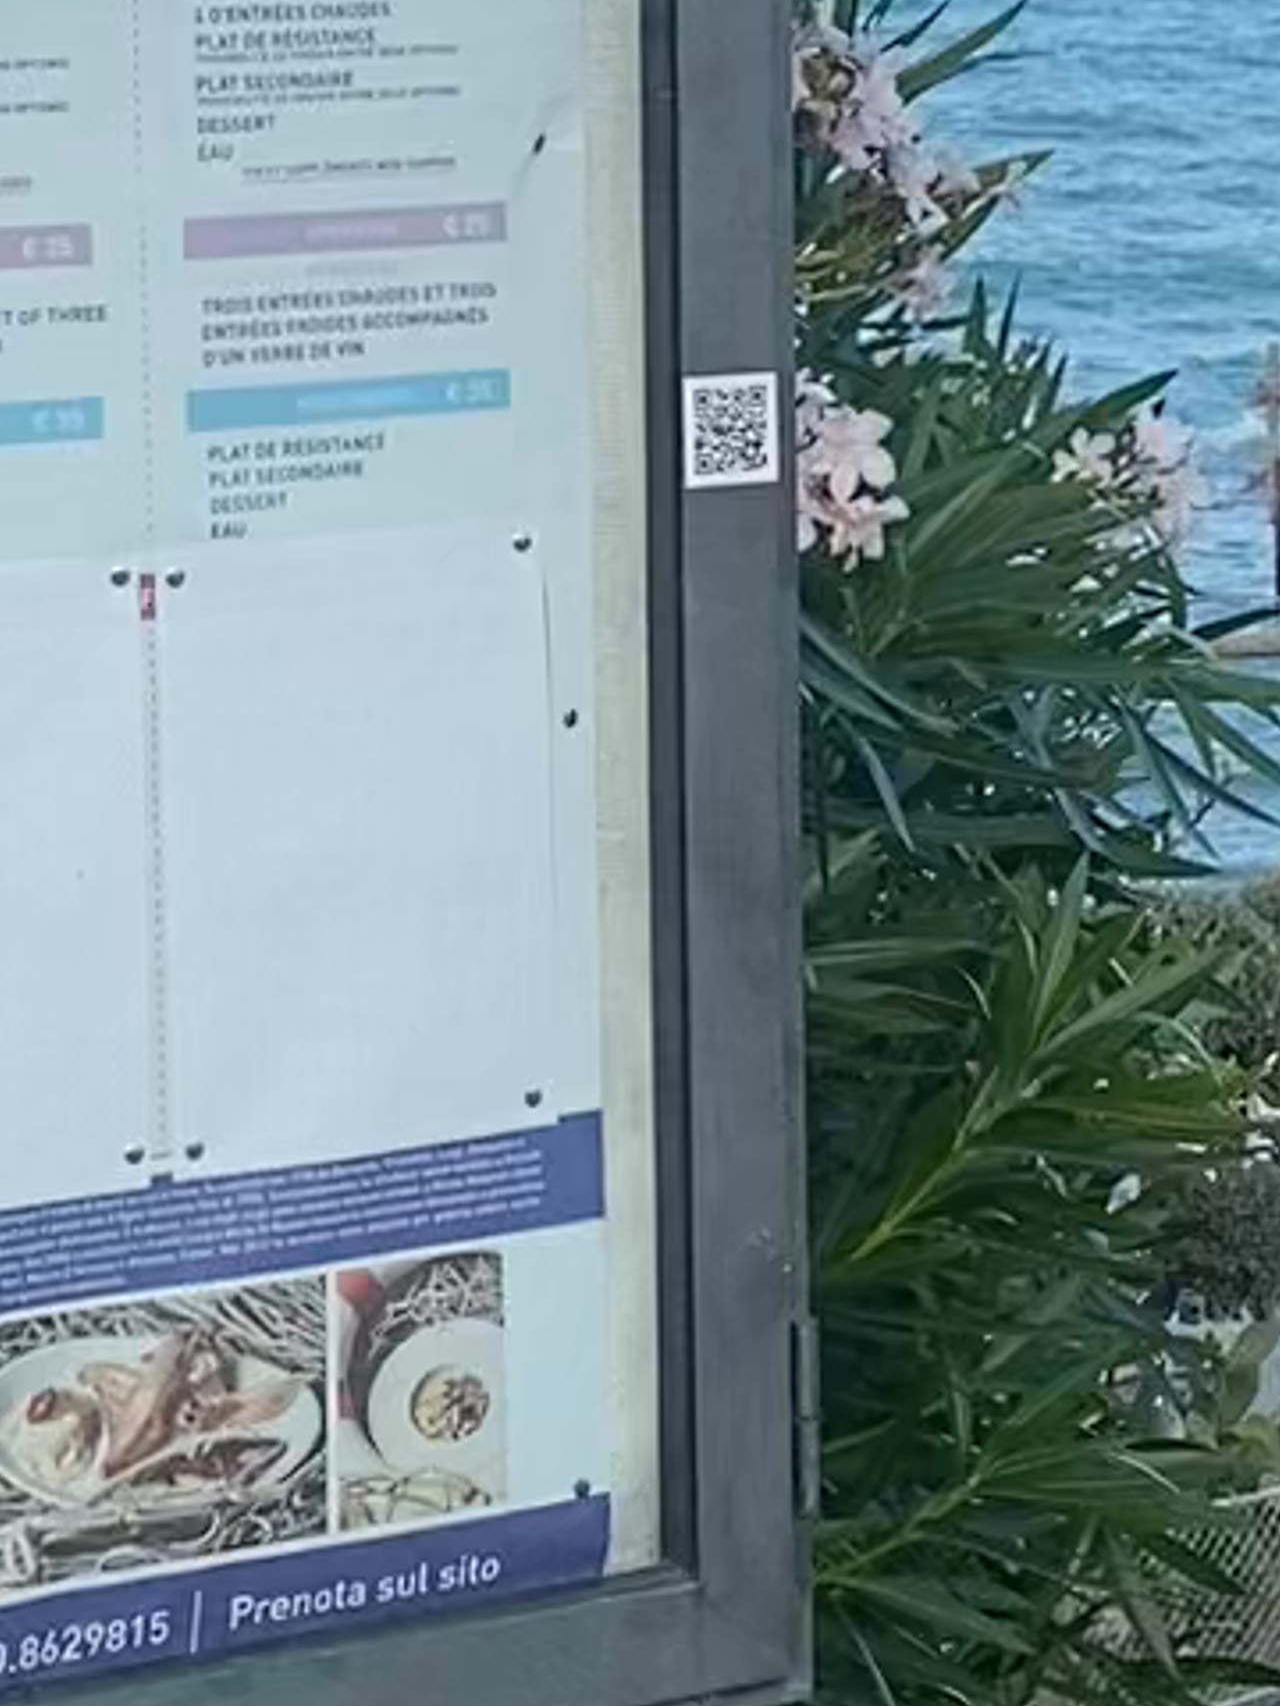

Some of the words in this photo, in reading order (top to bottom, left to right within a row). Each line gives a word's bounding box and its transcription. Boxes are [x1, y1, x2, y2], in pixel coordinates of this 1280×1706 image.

[230, 1579, 368, 1633] Prenota
[377, 1562, 428, 1604] sul
[439, 1552, 501, 1591] sito
